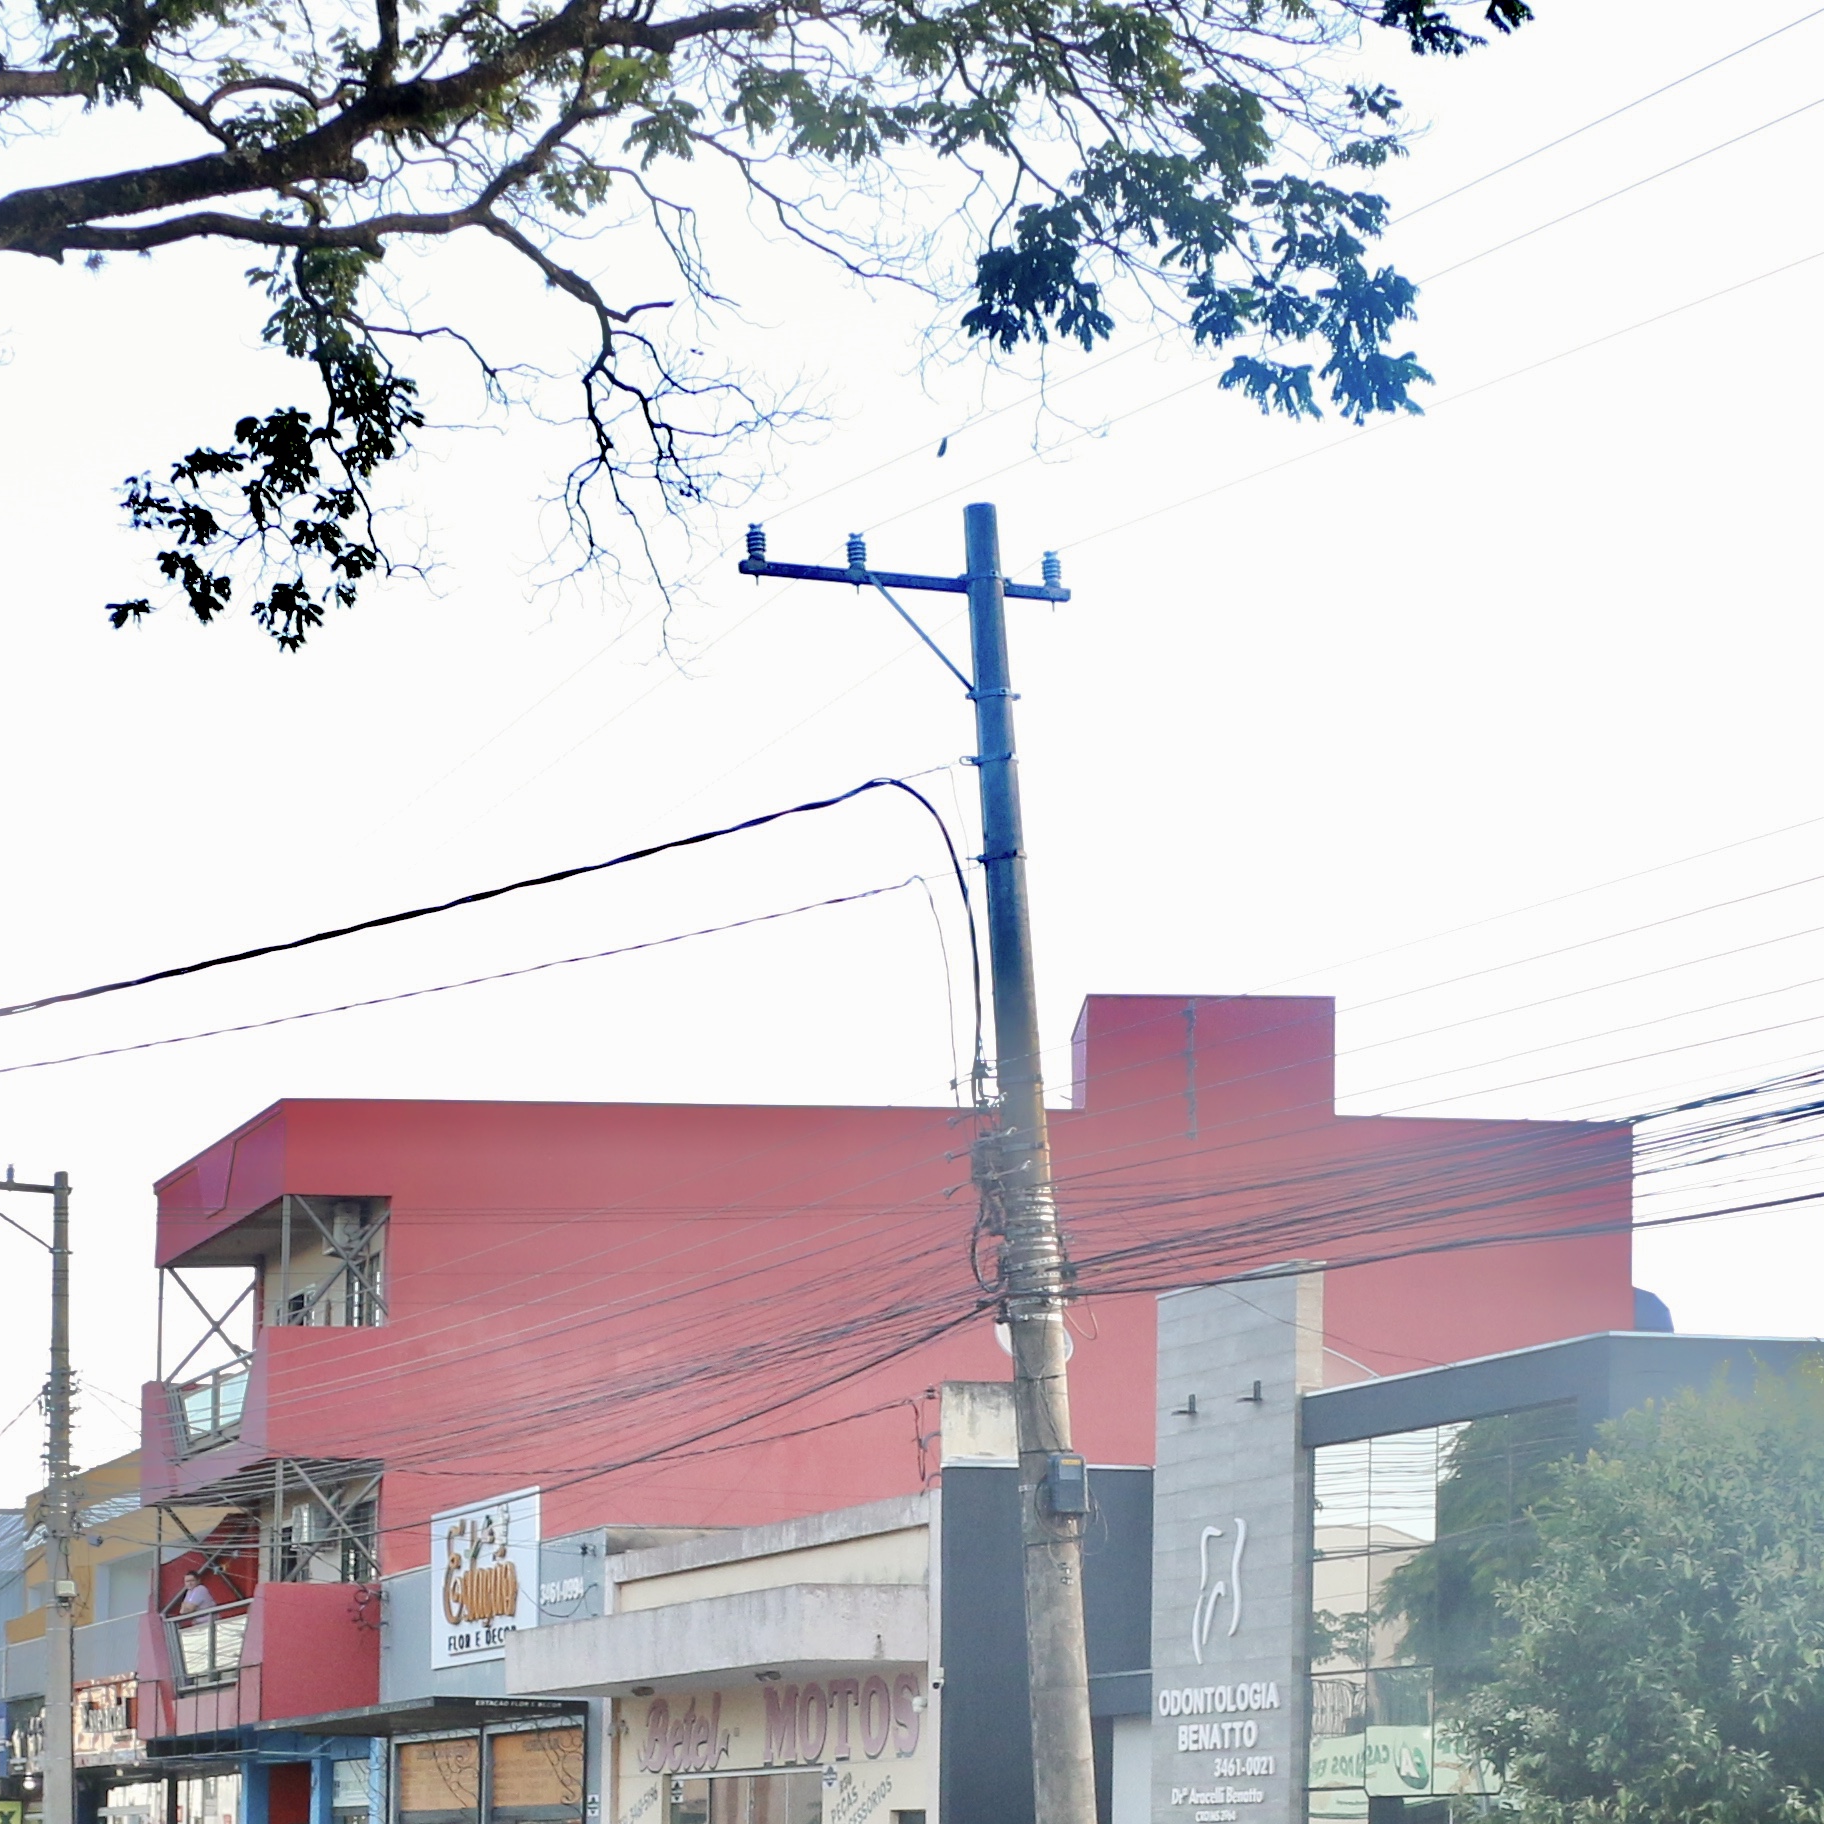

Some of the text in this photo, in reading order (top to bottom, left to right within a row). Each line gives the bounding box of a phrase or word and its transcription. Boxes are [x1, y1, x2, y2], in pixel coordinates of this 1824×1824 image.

[447, 1630, 471, 1652] FLOR
[475, 1629, 482, 1648] E
[1158, 1681, 1280, 1717] ODONTOLOGIA
[637, 1673, 922, 1774] Betel MOTOS
[1177, 1719, 1258, 1753] BENATTO
[1214, 1756, 1275, 1778] 3461-0021
[1226, 1786, 1265, 1803] Benatto
